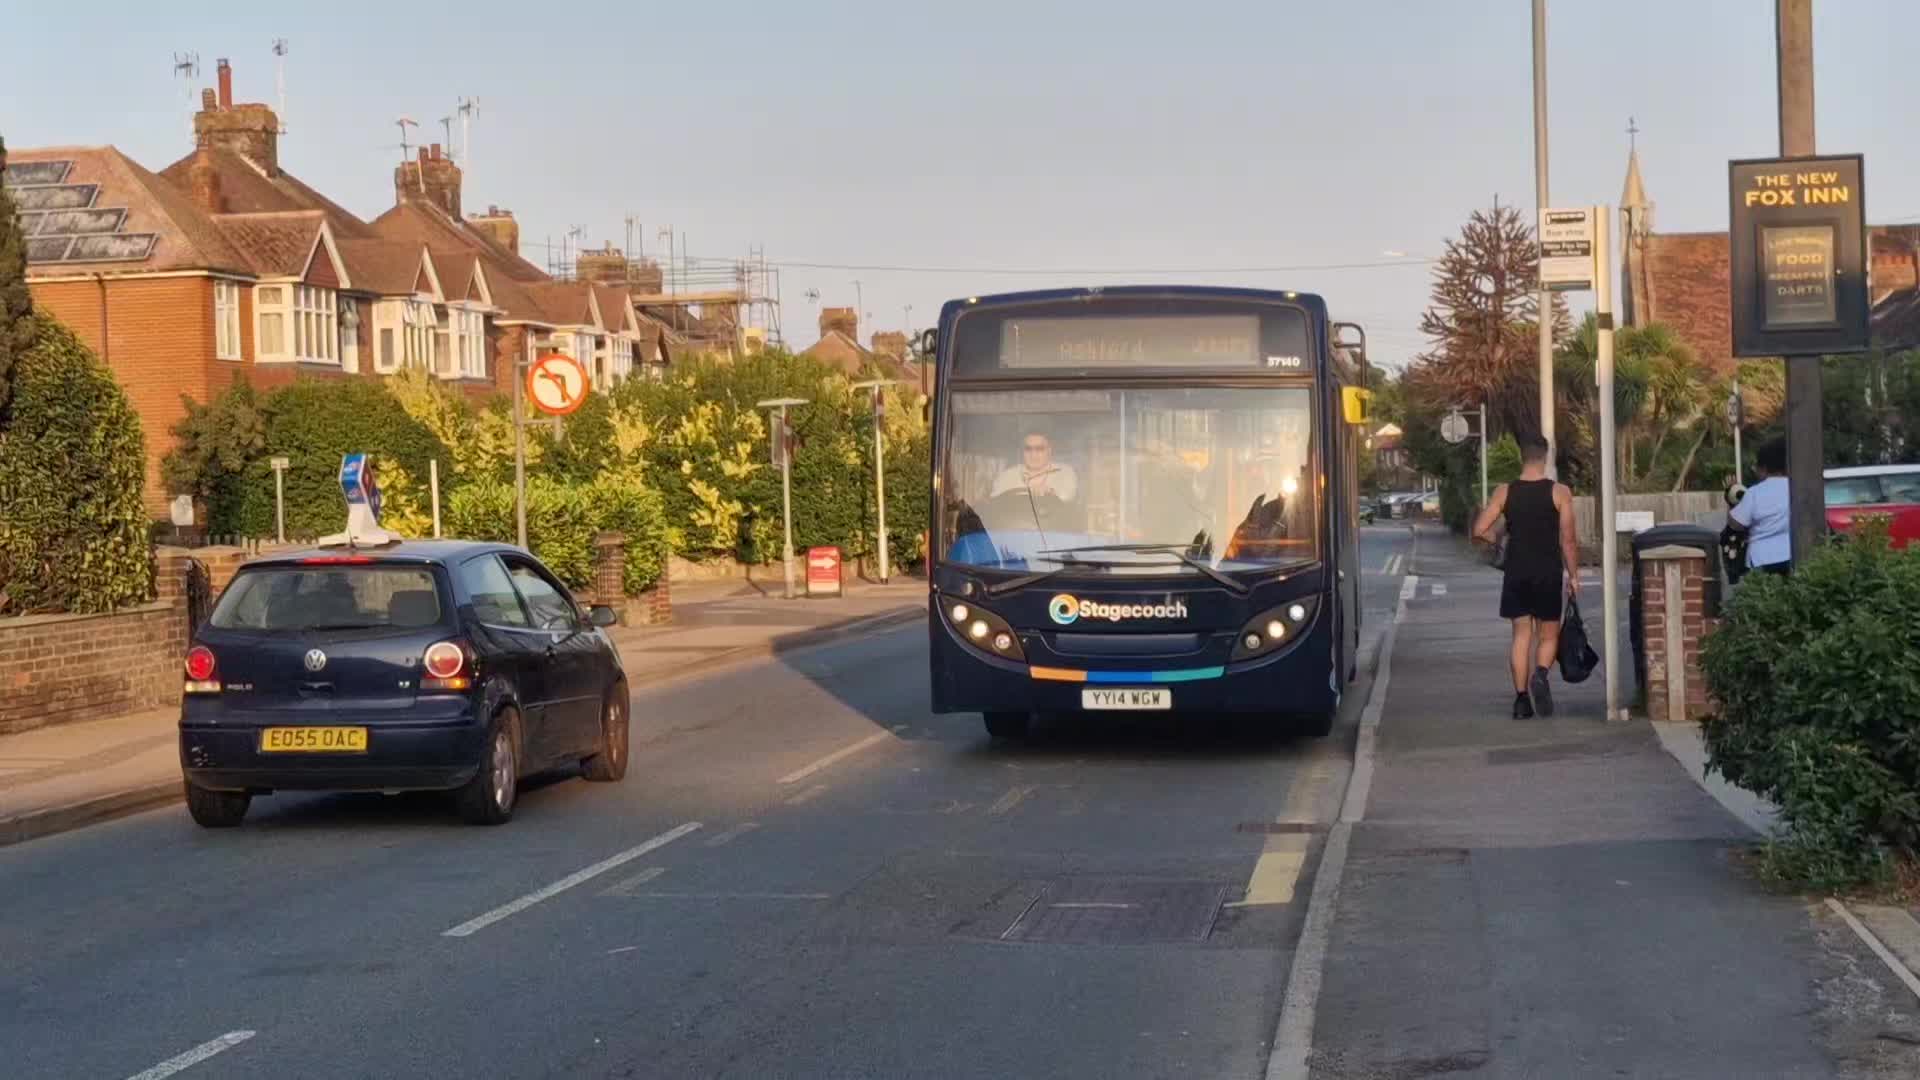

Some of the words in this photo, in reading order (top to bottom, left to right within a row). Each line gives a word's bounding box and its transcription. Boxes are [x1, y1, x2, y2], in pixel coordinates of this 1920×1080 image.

[1755, 174, 1791, 187] THE
[1796, 171, 1838, 185] NEW
[1745, 189, 1796, 207] FOX
[1804, 185, 1848, 204] INN
[1776, 253, 1823, 266] FOOD
[1778, 286, 1824, 297] DARTS
[1079, 600, 1188, 622] Stagecoach
[1093, 691, 1126, 705] YY14
[1132, 691, 1161, 705] WGW
[271, 729, 318, 747] EO55
[323, 729, 359, 747] OAC
